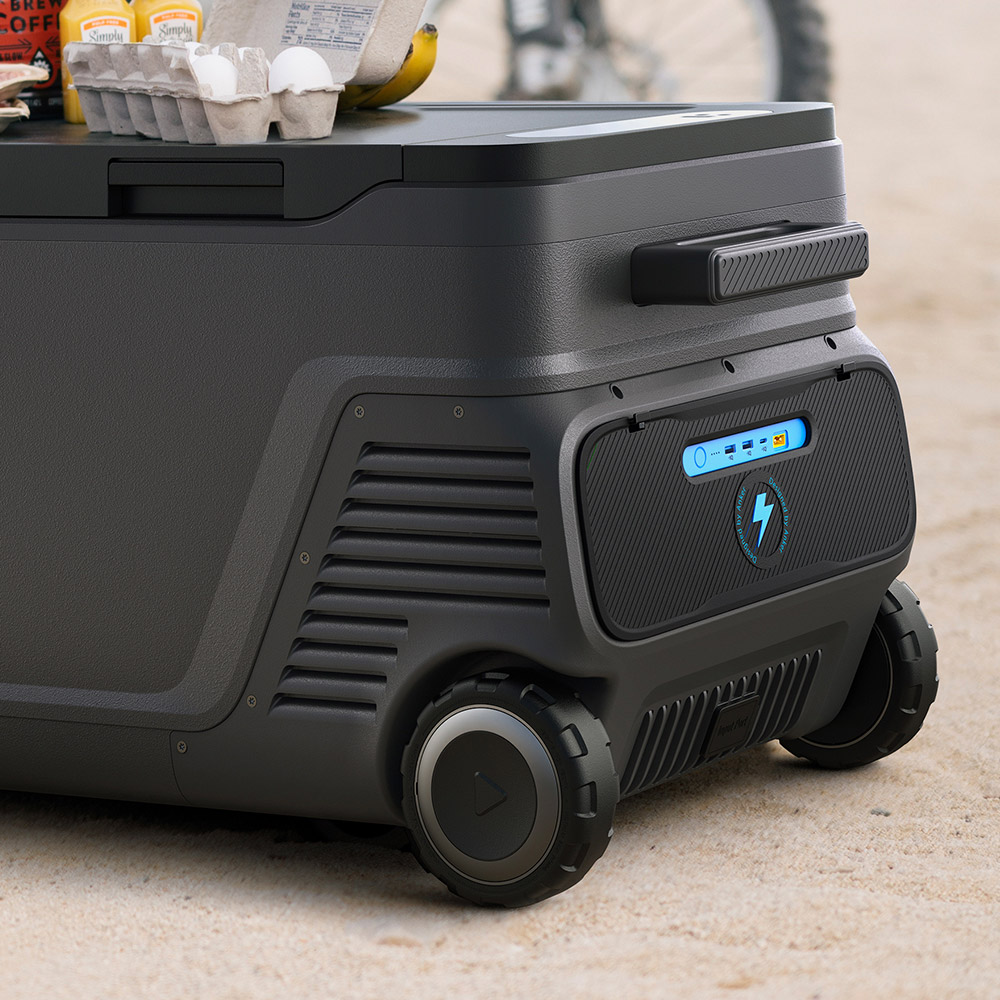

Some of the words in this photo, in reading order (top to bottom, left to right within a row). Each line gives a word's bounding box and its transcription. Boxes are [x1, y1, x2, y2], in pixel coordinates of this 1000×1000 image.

[89, 29, 123, 42] Simply
[159, 22, 192, 39] Simply
[736, 487, 746, 512] Anker
[769, 477, 789, 513] Designed
[779, 529, 789, 553] Anker
[737, 528, 757, 563] Designed
